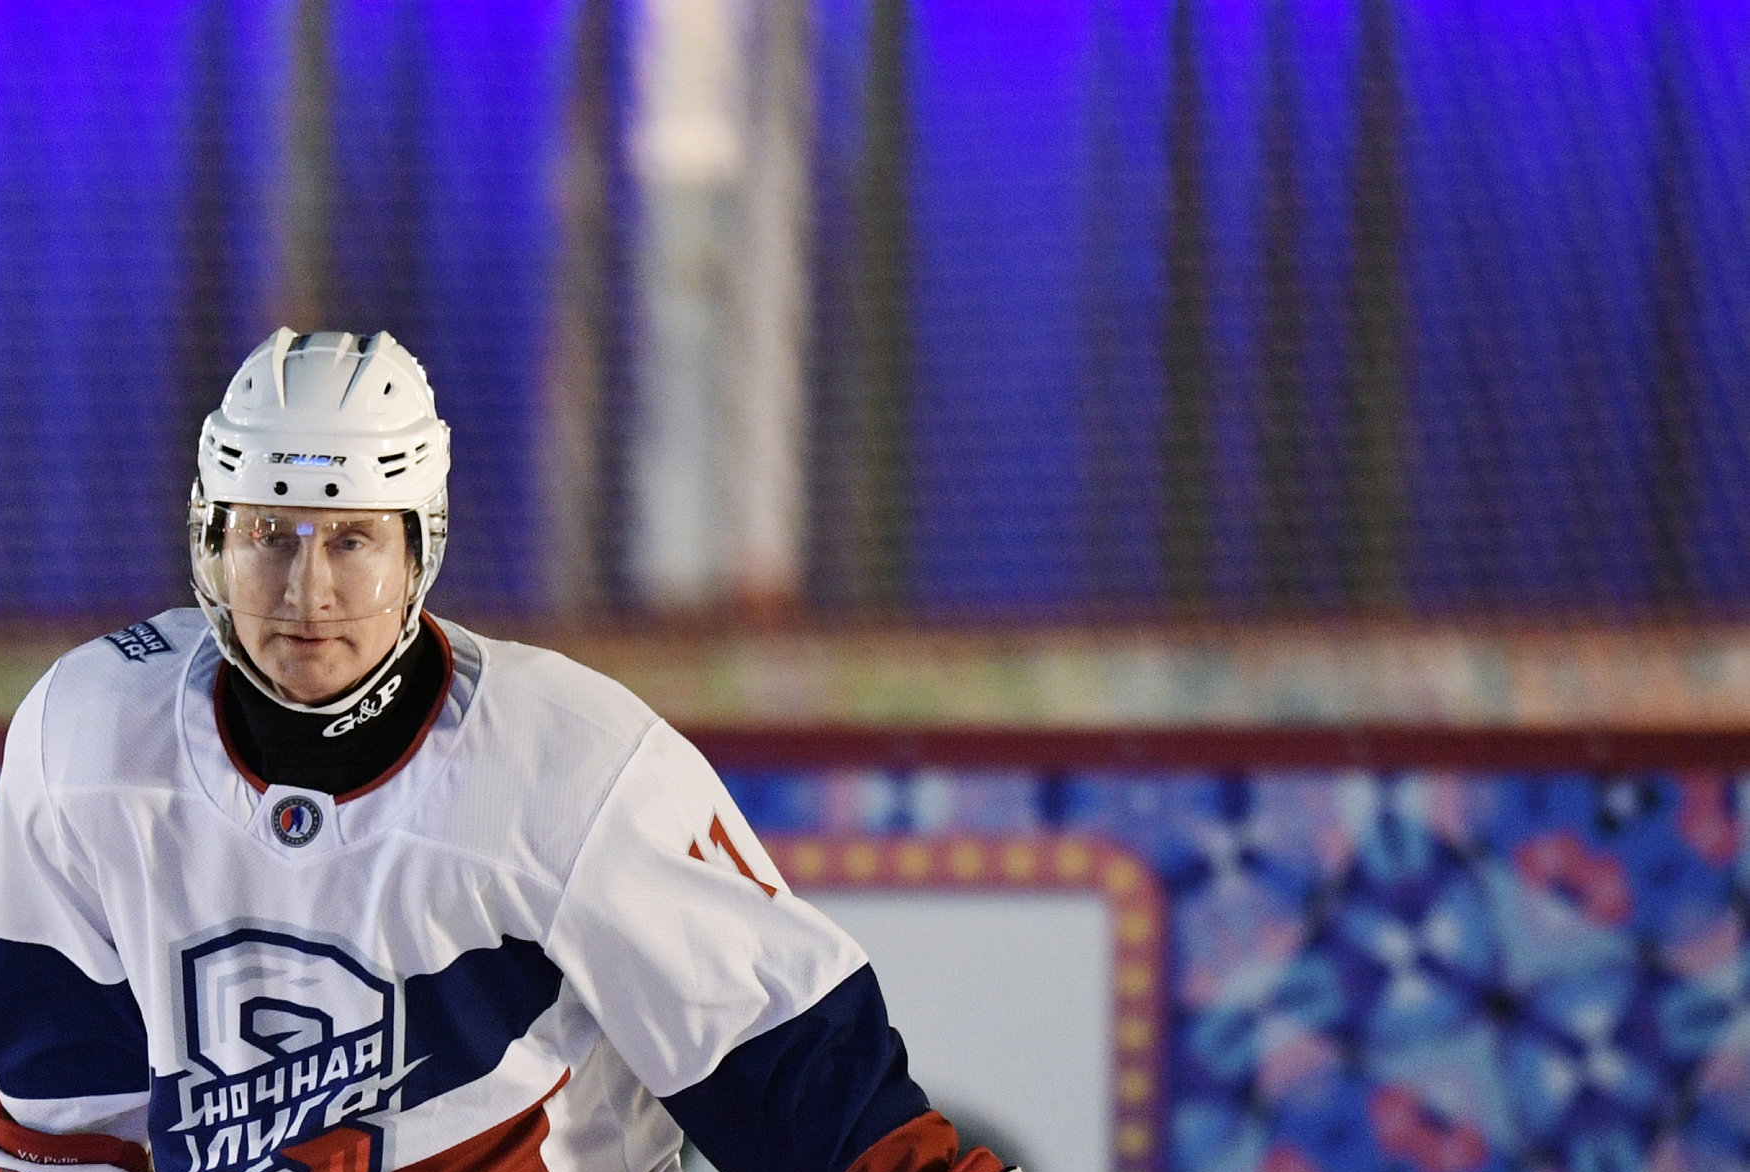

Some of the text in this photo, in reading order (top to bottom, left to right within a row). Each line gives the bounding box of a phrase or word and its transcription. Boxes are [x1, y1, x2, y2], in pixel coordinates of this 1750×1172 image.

[322, 674, 402, 737] G&P
[203, 1030, 383, 1127] НОЧНАЯ
[206, 1072, 383, 1171] ЛИГА
